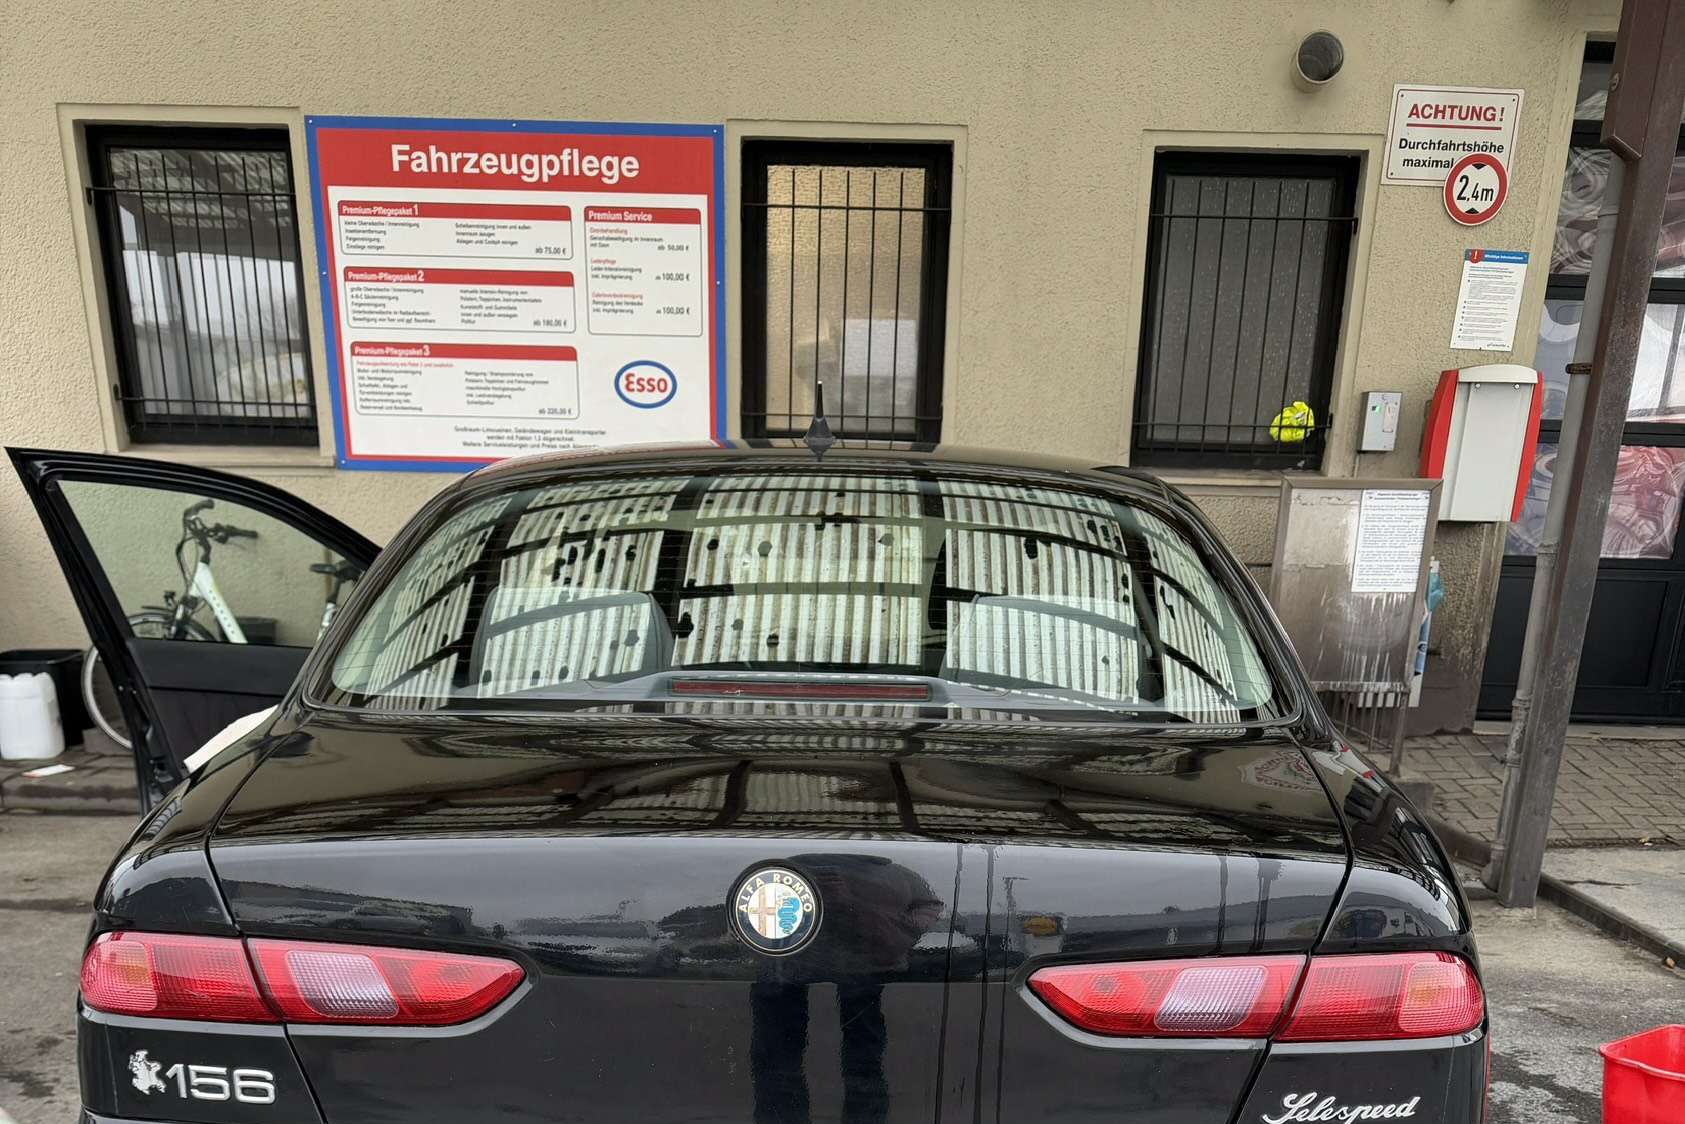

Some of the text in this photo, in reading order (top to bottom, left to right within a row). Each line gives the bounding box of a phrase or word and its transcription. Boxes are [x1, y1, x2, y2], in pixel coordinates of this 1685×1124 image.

[1399, 138, 1504, 153] Durchfahrtshöhe
[391, 144, 639, 184] Fahrzeugpflege
[1403, 157, 1454, 169] maximal
[342, 204, 419, 216] Premium-Pflegepaket 1
[589, 210, 652, 221] Premium Service
[348, 270, 424, 282] Premium-Pflegepaket 2
[355, 345, 430, 356] Premium-Pflegepaket 3
[625, 373, 668, 393] Esso
[739, 873, 812, 912] ALFA ROMEO
[166, 1064, 275, 1104] 156
